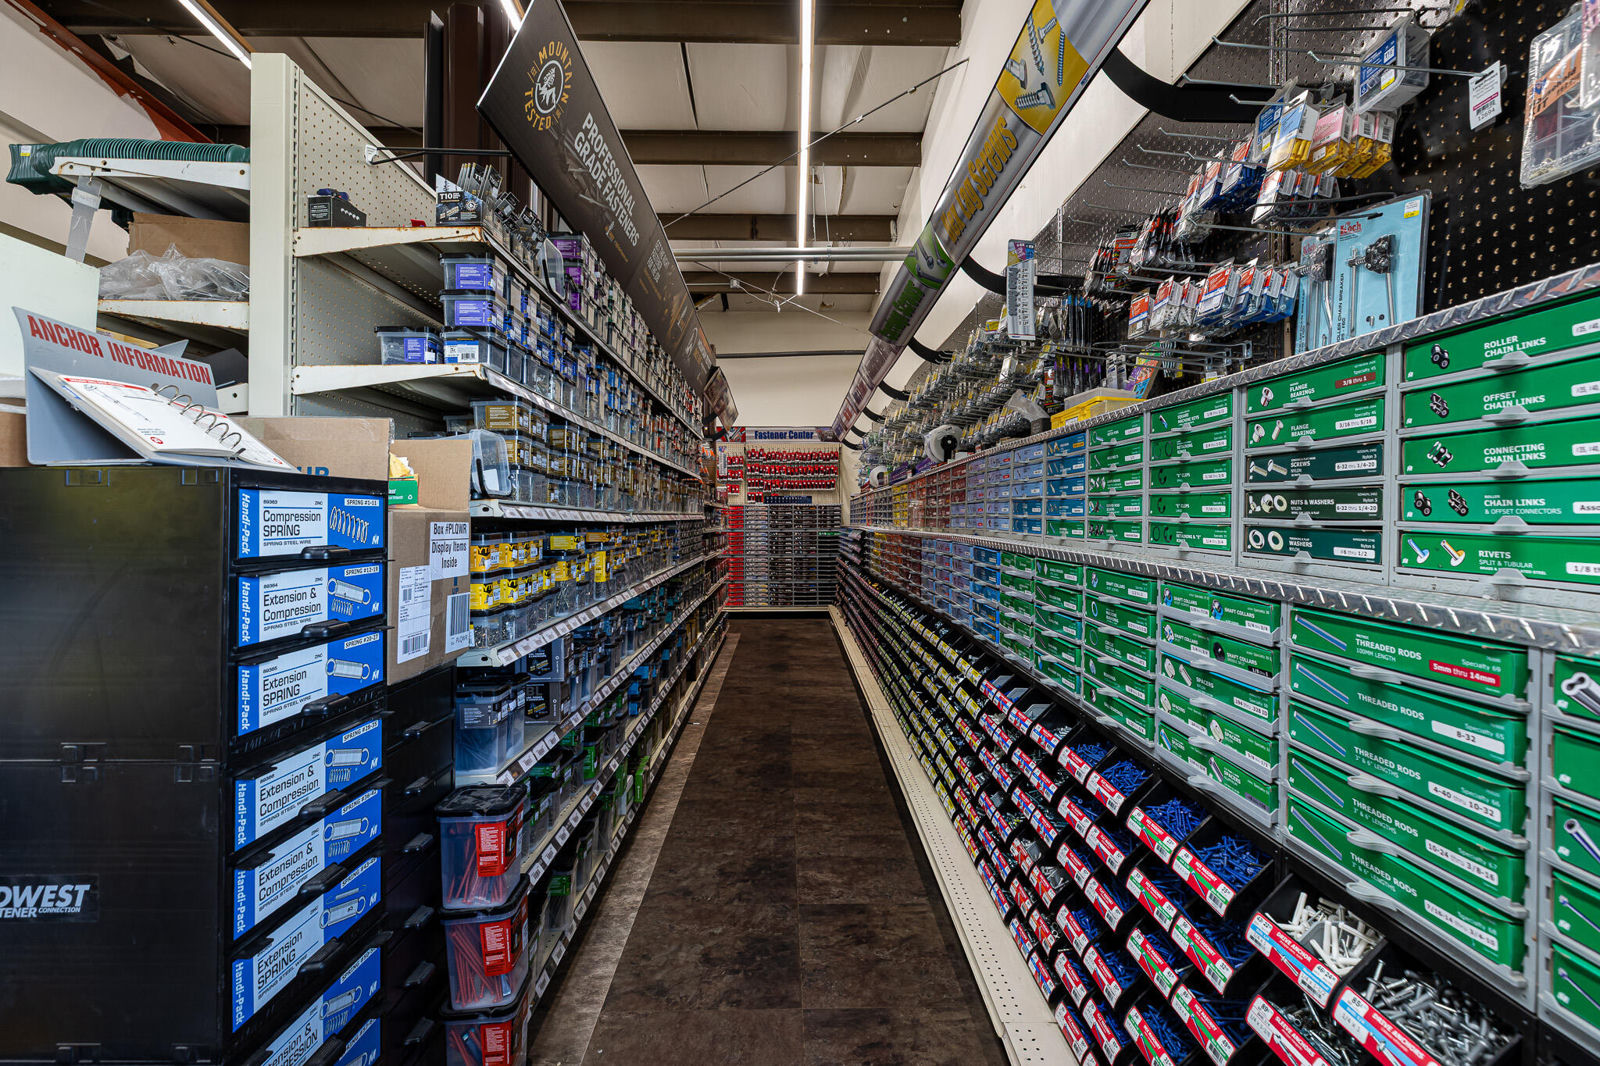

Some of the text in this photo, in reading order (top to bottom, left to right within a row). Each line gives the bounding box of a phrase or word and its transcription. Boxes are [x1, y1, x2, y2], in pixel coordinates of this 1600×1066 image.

[538, 41, 573, 104] MOUNTAIN
[524, 87, 552, 131] TESTED
[582, 112, 636, 217] PROFESSIONAL
[968, 116, 1018, 197] Screws
[574, 131, 640, 247] GRADE FASTENERS
[953, 176, 984, 221] Lag
[27, 314, 212, 385] ANCHOR INFORMATION
[1483, 335, 1518, 350] ROLLER
[1484, 337, 1547, 358] CHAIN LINKS
[1289, 383, 1308, 392] FLANGE
[1290, 388, 1315, 399] BEARINGS
[1483, 390, 1517, 402] OFFSET
[1483, 394, 1545, 411] CHAIN LINKS
[754, 430, 814, 440] Fastener Center
[1290, 423, 1309, 431] FLANGE
[1291, 428, 1316, 438] BEARINGS
[1483, 443, 1545, 456] CONNECTING
[1484, 451, 1546, 464] CHAIN LINKS
[1290, 460, 1311, 468] SCREWS
[1357, 461, 1375, 469] 1/4-20
[1484, 499, 1546, 507] CHAIN LINKS
[241, 493, 251, 555] Handi-Pack
[263, 509, 321, 525] Compression
[263, 524, 301, 538] SPRING
[433, 523, 467, 535] Box #PLQWR
[431, 541, 452, 555] Display
[452, 541, 467, 552] Items
[1288, 540, 1313, 548] WASHERS
[441, 557, 458, 569] Inside
[1478, 550, 1512, 559] RIVETS
[1503, 561, 1533, 569] TUBULAR
[263, 587, 317, 607] Extension &
[241, 582, 251, 643] Handi-Pack
[263, 602, 322, 622] Compression
[1237, 610, 1255, 619] COLLARS
[263, 624, 284, 632] SPRING
[283, 621, 298, 629] STEEL
[345, 638, 363, 649] SPRING
[1355, 638, 1422, 660] THREADED RODS
[1239, 656, 1257, 666] COLLARS
[1374, 651, 1396, 662] LENGTH
[1461, 658, 1490, 671] Specialty
[263, 670, 307, 692] Extension
[1432, 662, 1496, 684] 5mm thru 14mm
[1195, 676, 1214, 689] SPACERS
[241, 669, 251, 731] Handi-Pack
[262, 683, 301, 707] SPRING
[263, 700, 300, 717] SPRING STEEL
[1357, 692, 1425, 720] THREADED RODS
[343, 728, 362, 742] SPRING
[1456, 730, 1476, 743] 8-32
[1464, 723, 1494, 738] Specialty
[1353, 746, 1421, 780] THREADED RODS
[1373, 762, 1399, 779] LENGTHS
[260, 764, 315, 801] Extension &
[260, 778, 319, 817] Compression
[1432, 786, 1495, 817] 4-40 10-32
[237, 783, 247, 845] Handi-Pack
[342, 799, 361, 815] SPRING
[1352, 798, 1419, 837] THREADED RODS
[1372, 817, 1397, 835] LENGTHS
[1428, 842, 1449, 859] 10-24
[258, 841, 314, 887] Extension &
[258, 855, 318, 902] Compression
[1350, 852, 1418, 897] THREADED RODS
[1370, 873, 1396, 893] LENGTHS
[38, 906, 81, 914] CONNECTION
[237, 870, 246, 933] Handi-Pack
[257, 931, 303, 975] Extension
[1276, 931, 1293, 946] DRIVE
[1291, 944, 1312, 963] ANCHOR
[257, 948, 296, 990] SPRING
[235, 962, 245, 1025] Handi-Pack
[1274, 1016, 1292, 1036] SLEEVE
[1289, 1031, 1316, 1057] ANCHORS
[1372, 1013, 1394, 1032] DRIVE
[1391, 1028, 1425, 1059] ANCHORS
